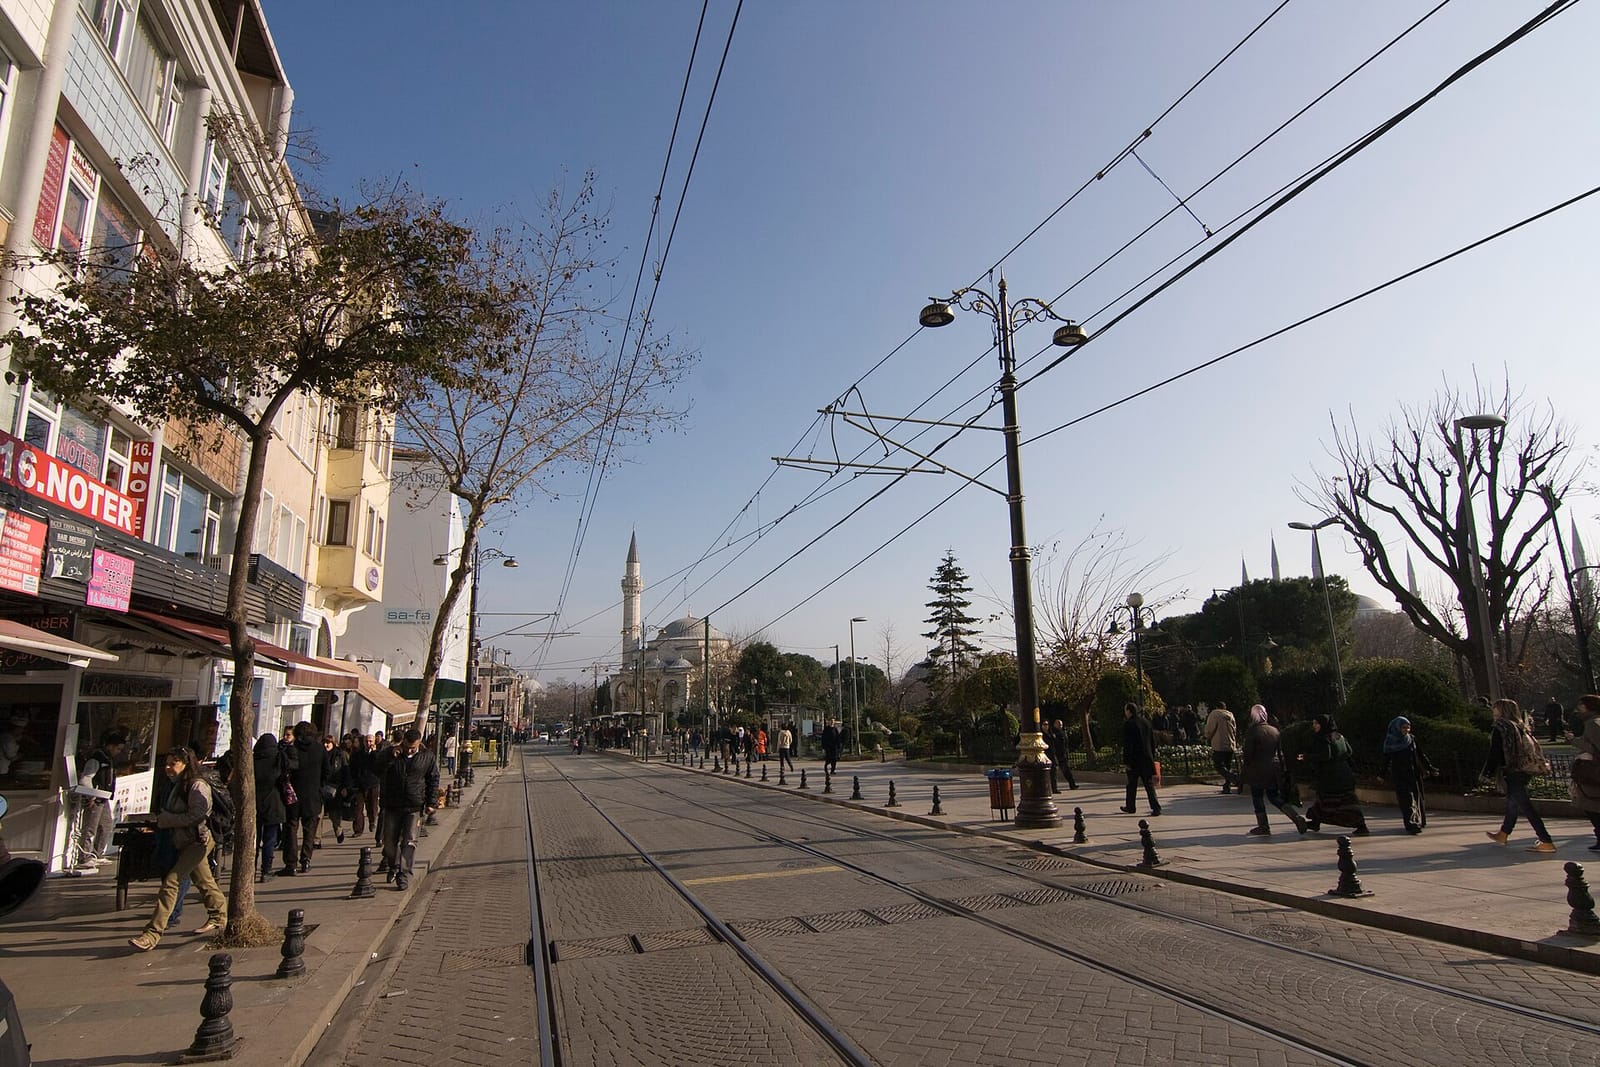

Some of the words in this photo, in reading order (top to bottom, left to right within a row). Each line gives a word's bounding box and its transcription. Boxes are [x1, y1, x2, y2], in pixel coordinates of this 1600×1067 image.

[57, 434, 99, 479] NOTER
[134, 443, 152, 457] 16.
[387, 609, 431, 620] sa-fa
